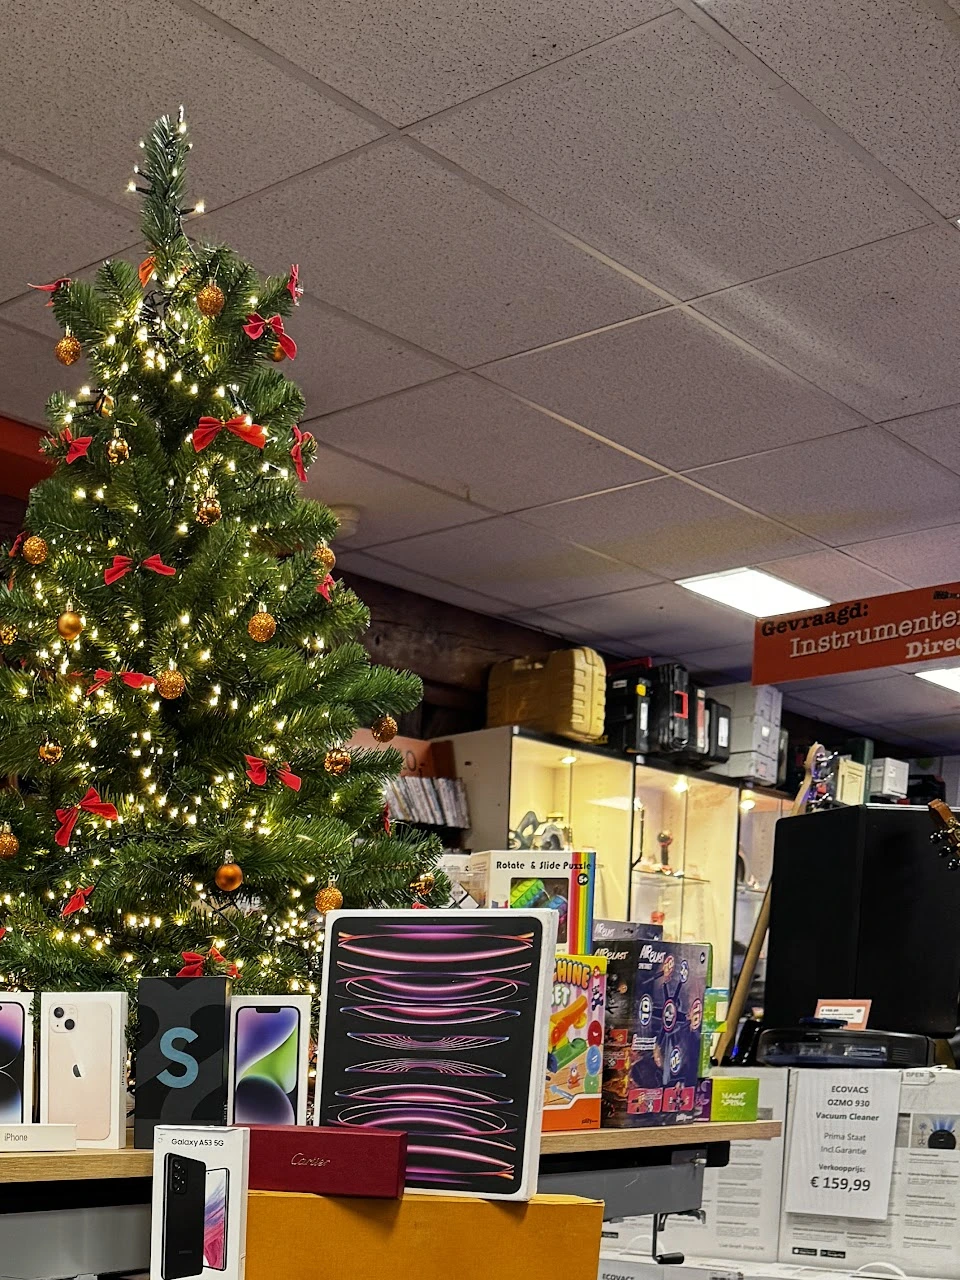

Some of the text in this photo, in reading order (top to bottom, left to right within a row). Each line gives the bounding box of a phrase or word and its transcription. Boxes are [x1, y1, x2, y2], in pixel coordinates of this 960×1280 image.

[761, 602, 869, 637] Gevraagd:
[496, 861, 592, 870] Rotate & Slide Puzzle
[831, 1085, 869, 1094] ECOVACS
[827, 1099, 870, 1108] OZMO 930
[816, 1112, 879, 1122] Vacuum Cleaner
[4, 1133, 28, 1142] iPhone
[823, 1132, 866, 1142] Prima Staat
[171, 1137, 224, 1149] Galaxy A53 5G
[291, 1152, 331, 1167] Cartier
[818, 1163, 866, 1173] Verkoopprijs:
[810, 1176, 871, 1193] € 159,99
